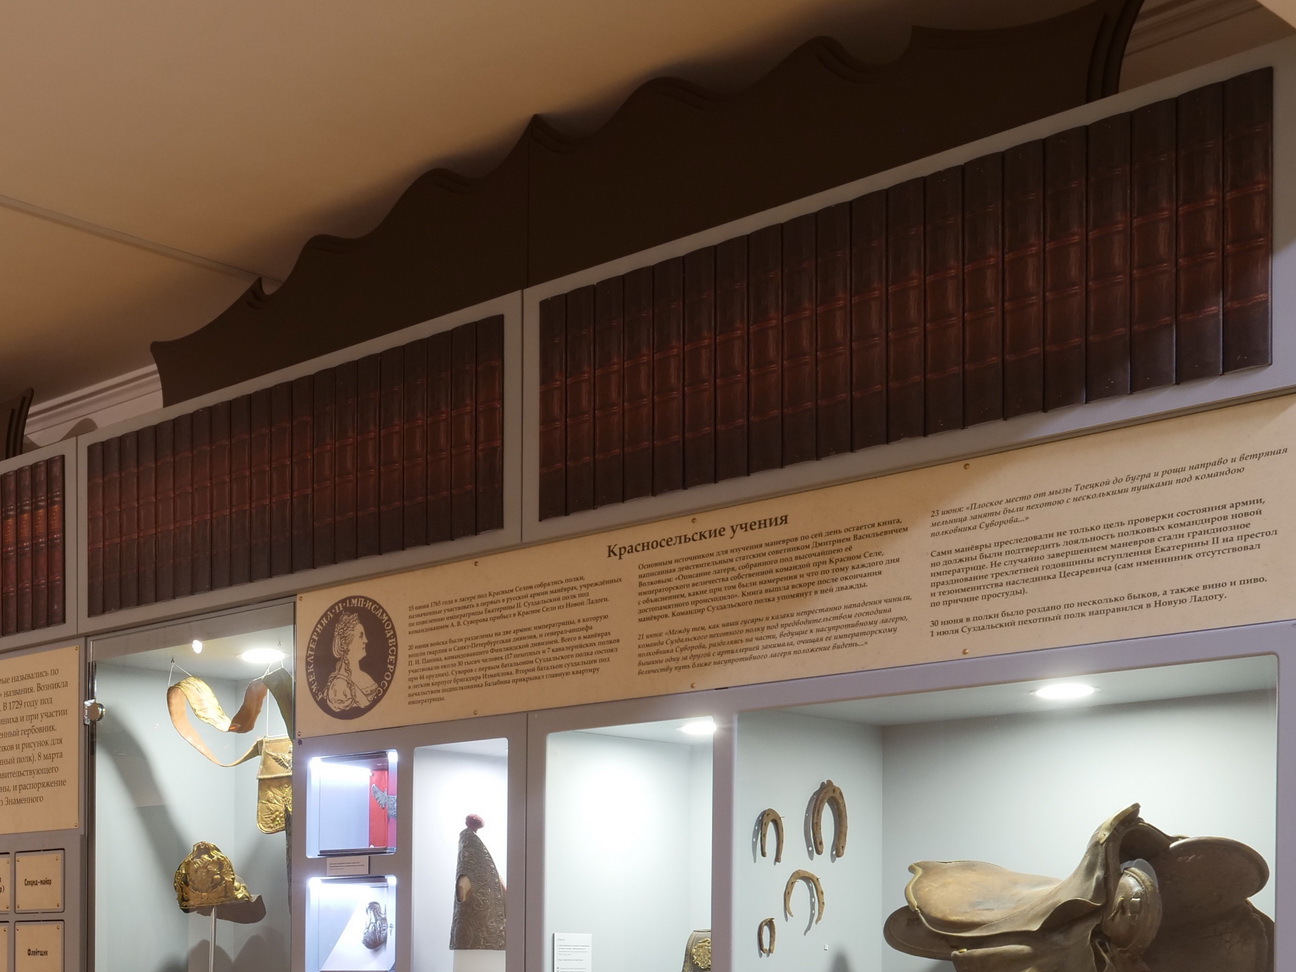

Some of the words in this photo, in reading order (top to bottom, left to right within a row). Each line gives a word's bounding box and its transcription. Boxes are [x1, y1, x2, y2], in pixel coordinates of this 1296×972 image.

[931, 515, 967, 527] мельница
[969, 509, 1000, 522] заняты
[1002, 505, 1023, 515] были
[1025, 498, 1064, 511] пехотою
[1072, 487, 1128, 502] несколькими
[1130, 479, 1173, 494] пушками
[1175, 473, 1192, 485] под
[1194, 466, 1244, 481] командою
[941, 505, 963, 515] июня:
[966, 498, 1003, 511] «Плоское
[1005, 493, 1031, 504] место
[1048, 486, 1072, 496] мызы
[1125, 472, 1151, 484] бугра
[1161, 466, 1186, 478] рощи
[1188, 456, 1228, 471] направо
[1238, 448, 1287, 463] ветряная
[607, 527, 726, 560] Красносельские
[729, 514, 789, 539] учения
[930, 548, 952, 557] Сами
[954, 541, 991, 553] манёвры
[993, 531, 1054, 548] преследовали
[1069, 523, 1100, 534] только
[1102, 519, 1125, 531] цель
[1127, 511, 1173, 526] проверки
[1176, 503, 1226, 517] состояния
[1229, 497, 1264, 510] армии,
[930, 524, 977, 537] полковника
[930, 563, 987, 577] императрице.
[1003, 552, 1044, 566] случайно
[1047, 544, 1107, 561] завершением
[1110, 536, 1155, 549] маневров
[1157, 532, 1184, 542] стали
[1187, 521, 1250, 539] грандиозное
[942, 554, 977, 567] должны
[979, 550, 1002, 559] были
[1004, 541, 1060, 556] подтвердить
[1062, 532, 1115, 546] лояльность
[1117, 524, 1165, 538] полковых
[1167, 514, 1228, 530] командиров
[1231, 506, 1262, 520] новой
[930, 572, 988, 588] празднование
[990, 562, 1039, 579] трехлетней
[1041, 556, 1094, 571] годовщины
[1096, 548, 1151, 562] вступления
[1154, 539, 1208, 553] Екатерины
[1236, 529, 1277, 543] престол
[938, 581, 1003, 597] тезоименитства
[1005, 573, 1056, 586] наследника
[1058, 565, 1111, 578] Цесаревича
[1114, 561, 1133, 573] (сам
[1136, 553, 1192, 567] именинник
[1195, 543, 1260, 559] отсутствовал
[936, 627, 959, 636] июля
[960, 617, 1015, 634] Суздальский
[1017, 611, 1061, 625] пехотный
[1063, 611, 1085, 620] полк
[1088, 603, 1143, 617] направился
[1154, 598, 1187, 608] Новую
[1189, 593, 1226, 604] Ладогу.
[940, 617, 963, 625] июня
[972, 612, 998, 621] полки
[1000, 608, 1024, 617] было
[1076, 595, 1124, 607] несколько
[1126, 590, 1159, 601] быков,
[1170, 585, 1199, 595] также
[1202, 581, 1227, 590] вино
[1239, 576, 1266, 586] пиво.
[942, 595, 979, 607] причине
[981, 586, 1027, 602] простуды).
[24, 878, 52, 886] Секунд-майор
